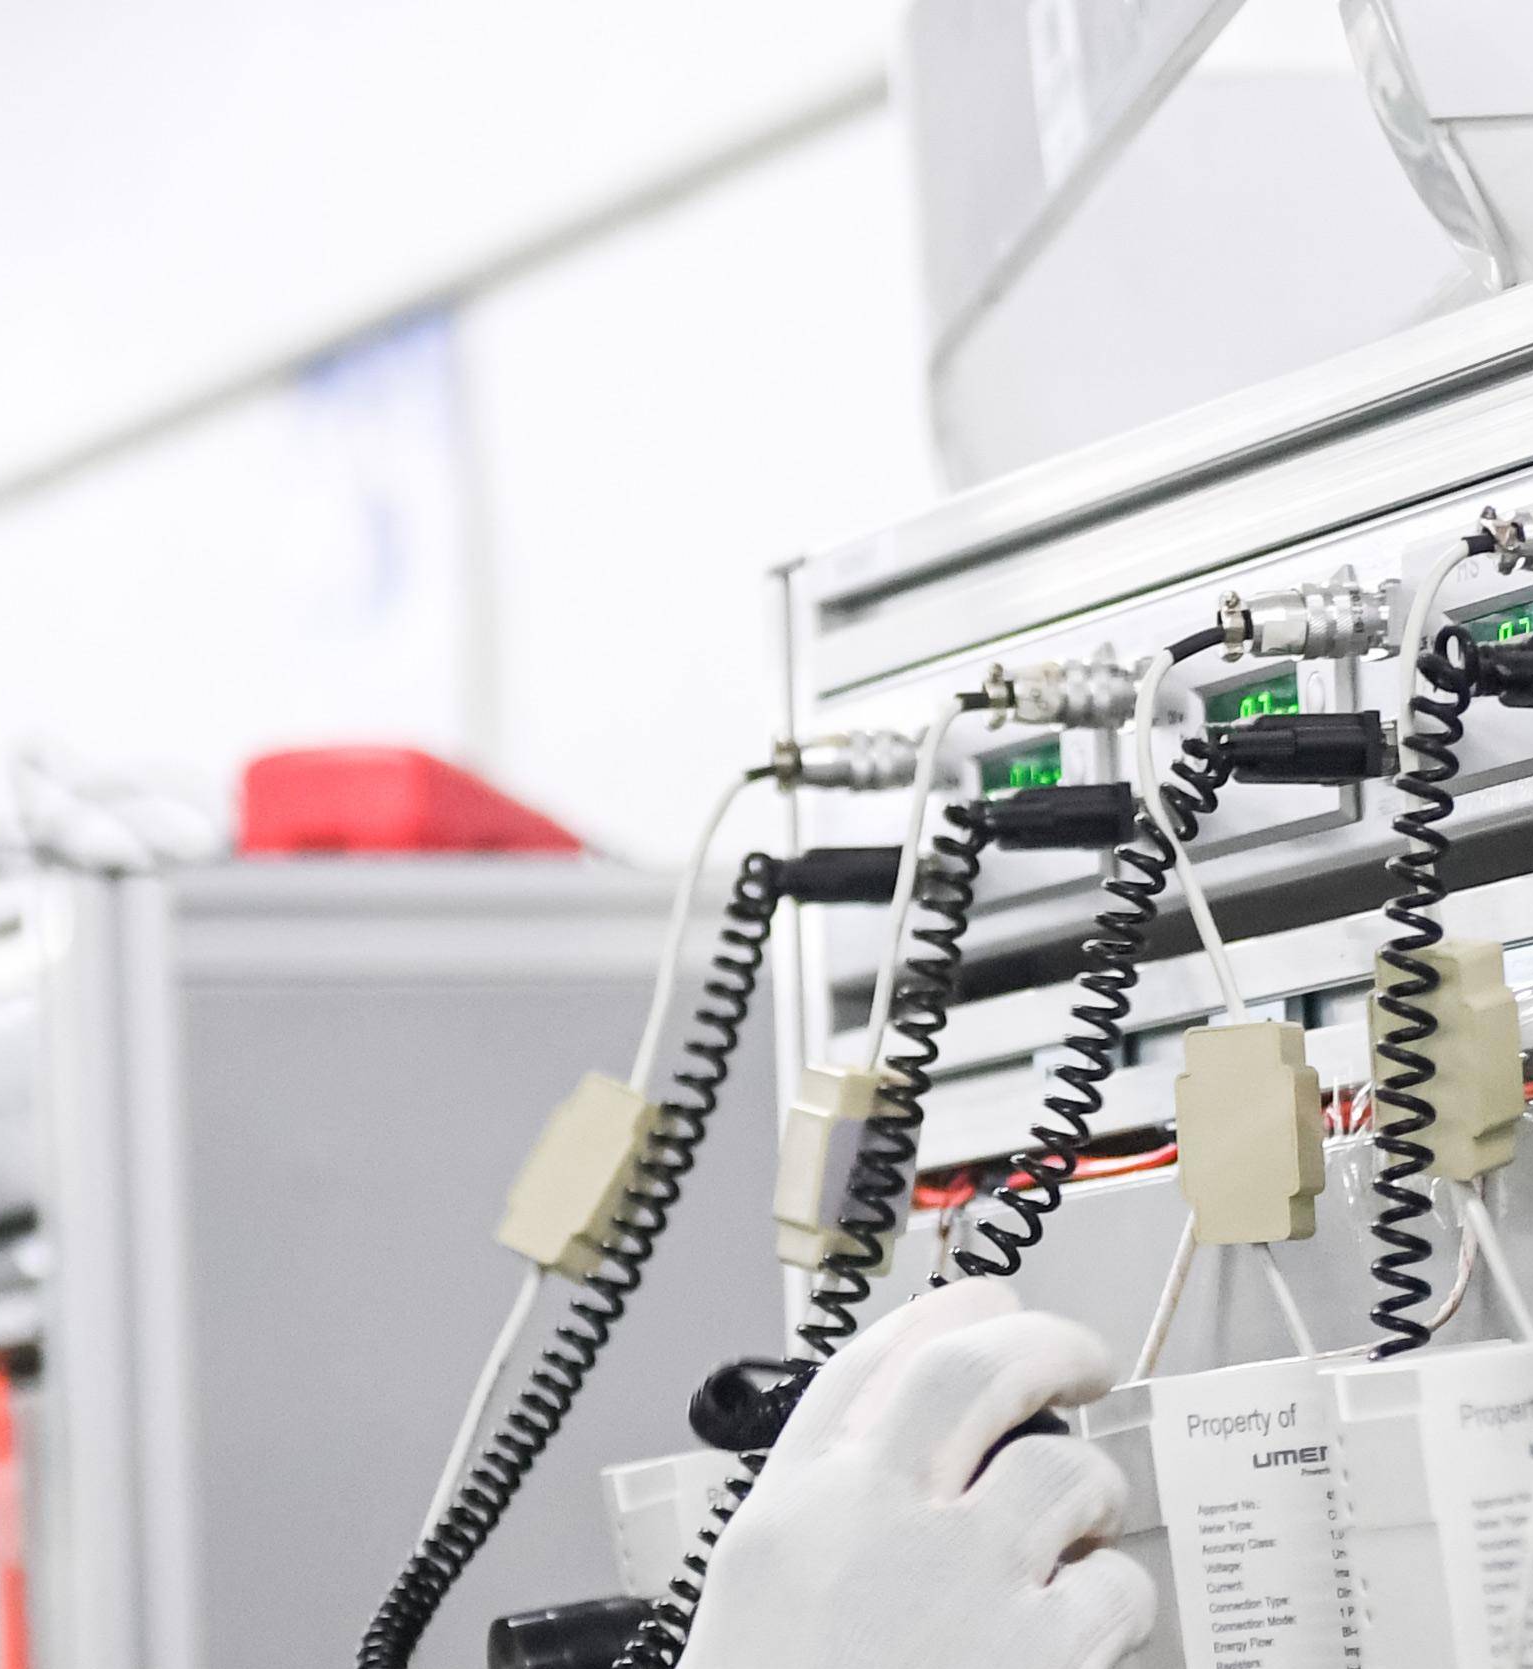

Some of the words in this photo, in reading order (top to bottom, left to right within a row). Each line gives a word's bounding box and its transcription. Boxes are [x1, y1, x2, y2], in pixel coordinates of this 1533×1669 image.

[1187, 1409, 1272, 1440] Property
[1278, 1402, 1296, 1428] of
[1202, 1541, 1246, 1556] Accuracy
[1209, 1599, 1263, 1614] Connection
[1212, 1619, 1265, 1634] Connection
[1213, 1641, 1247, 1654] Energy
